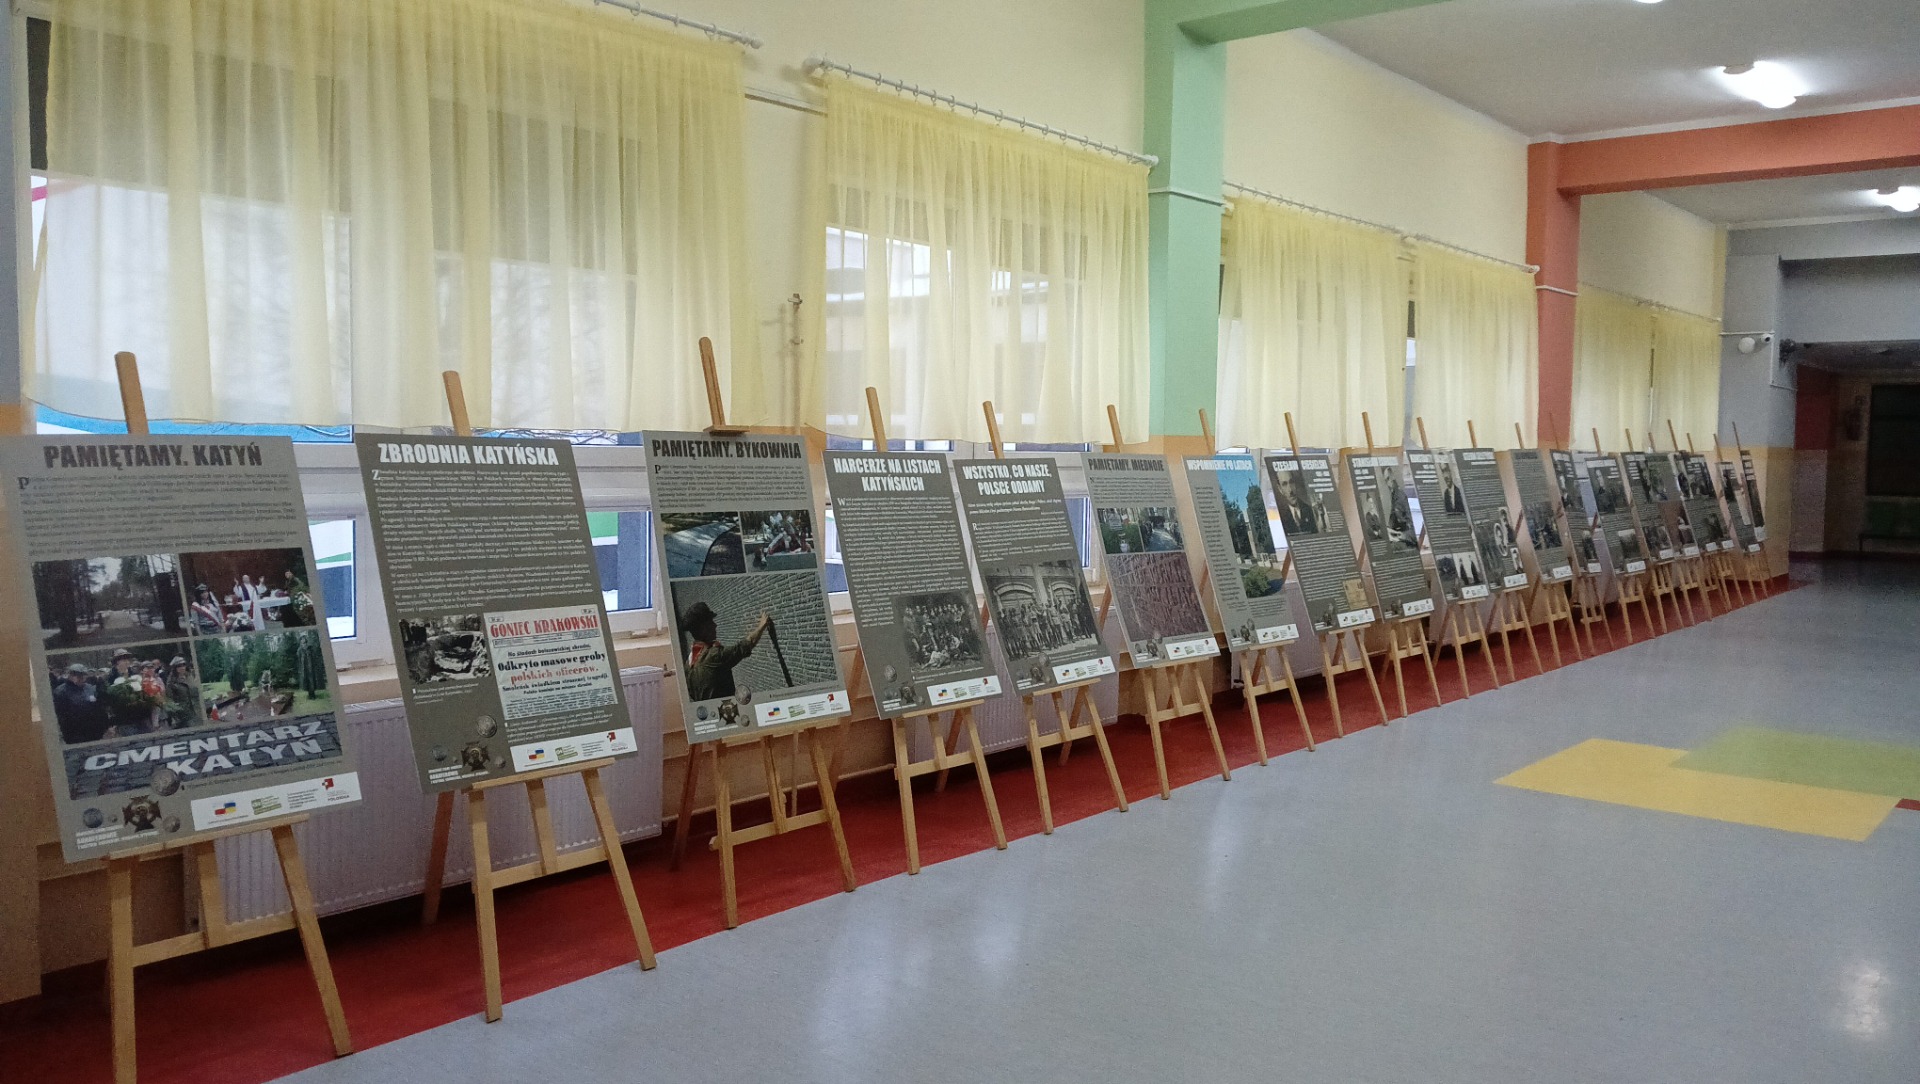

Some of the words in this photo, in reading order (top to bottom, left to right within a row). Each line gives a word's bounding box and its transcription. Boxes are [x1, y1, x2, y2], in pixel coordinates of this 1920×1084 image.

[44, 444, 188, 471] PAMIĘTAMY.
[193, 442, 263, 466] KATYŃ
[377, 443, 470, 464] ZBRODNIA
[472, 443, 559, 466] KATYŃSKA
[652, 440, 733, 460] PAMIĘTAMY.
[735, 442, 802, 459] BYKOWNIA
[833, 458, 887, 474] HARCERZE
[888, 458, 903, 473] NA
[904, 458, 942, 474] LISTACH
[962, 465, 1012, 480] WSZYSTKO,
[1012, 465, 1025, 479] CO
[861, 474, 924, 491] KATYŃSKICH
[978, 481, 1011, 496] POLSCE
[1012, 480, 1045, 493] ODDAMY
[490, 620, 531, 638] GONIEC
[534, 615, 598, 634] KRAKOWSKI
[498, 659, 539, 672] Odkryto
[540, 656, 578, 666] masowe
[579, 651, 606, 664] groby
[511, 670, 553, 684] polskich
[84, 721, 328, 771] CMENTARZ
[165, 736, 323, 776] KATYŃ
